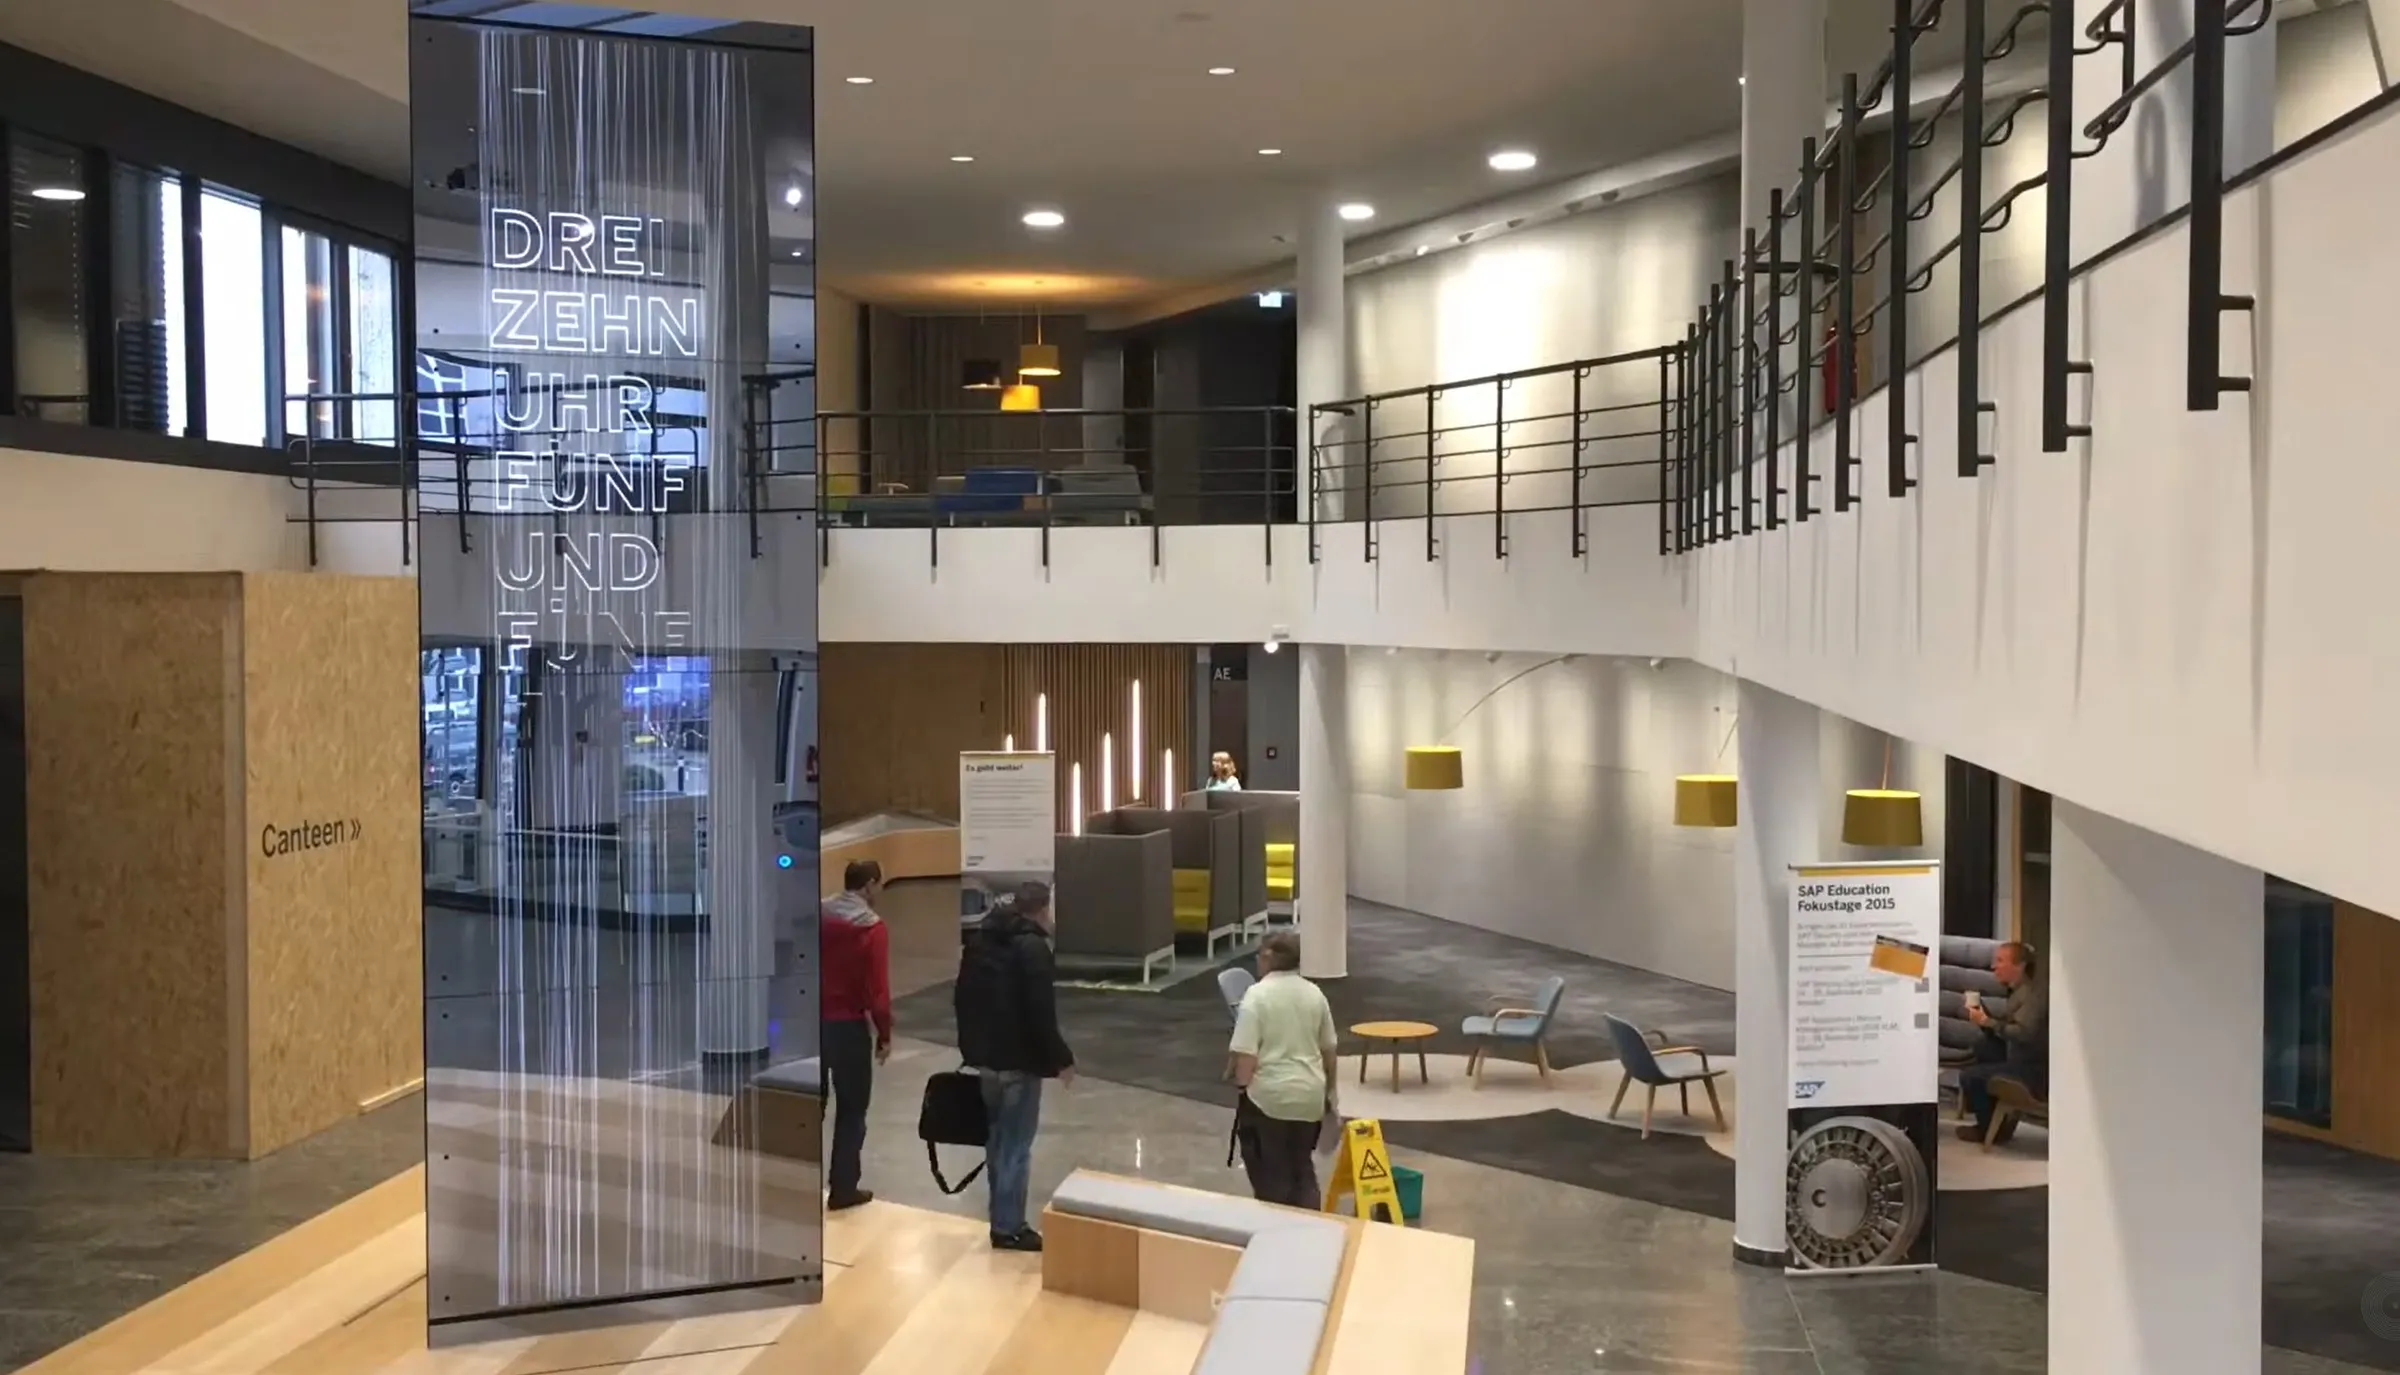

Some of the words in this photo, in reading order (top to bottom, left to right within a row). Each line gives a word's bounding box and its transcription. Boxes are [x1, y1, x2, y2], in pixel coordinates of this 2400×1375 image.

[490, 208, 665, 276] DREI
[490, 288, 698, 356] ZEHN
[494, 371, 654, 434] UHR
[495, 532, 660, 591] UND
[262, 819, 345, 858] Canteen
[1797, 884, 1824, 897] SAP
[1827, 883, 1890, 896] Education
[1797, 899, 1862, 913] Fokustage
[1865, 897, 1896, 910] 2015
[1795, 1081, 1825, 1099] SAP
